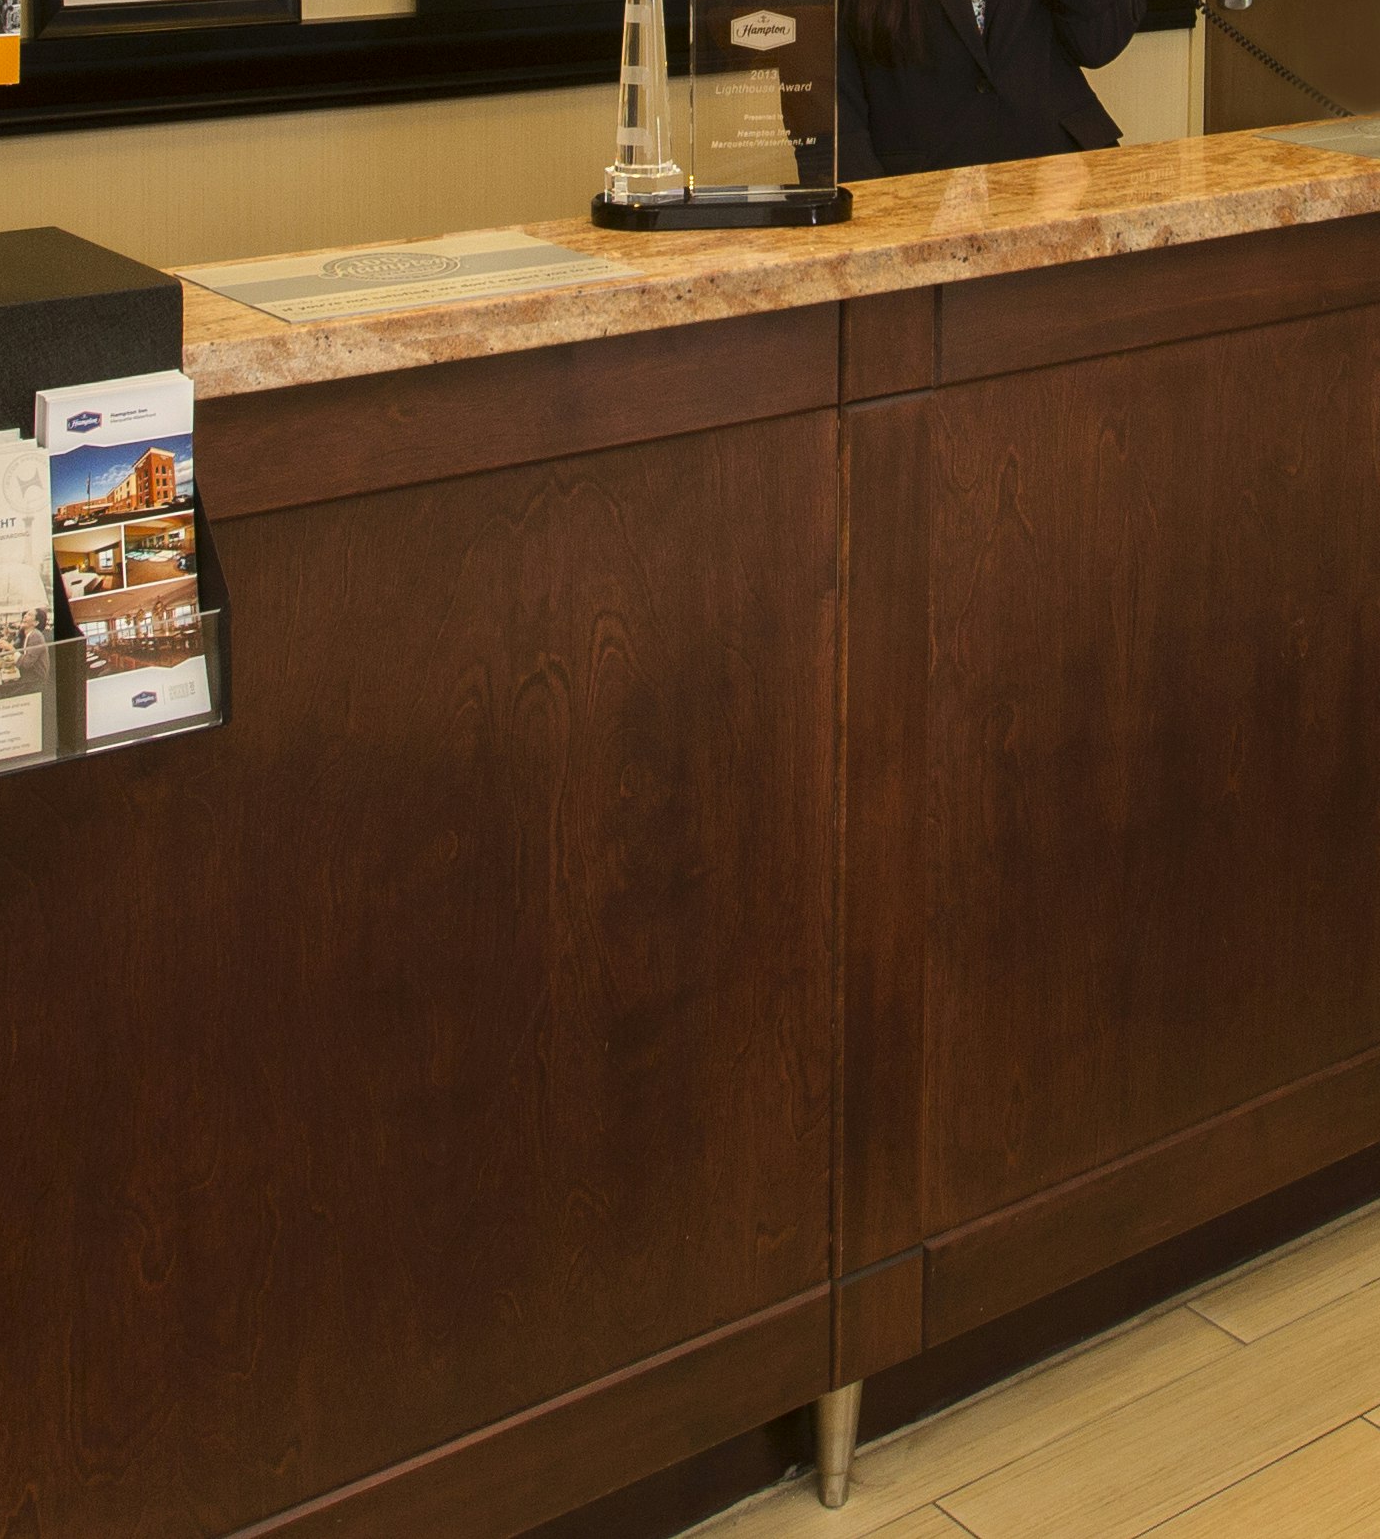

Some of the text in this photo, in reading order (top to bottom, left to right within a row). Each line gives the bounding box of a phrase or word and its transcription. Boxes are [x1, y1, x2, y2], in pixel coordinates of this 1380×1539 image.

[738, 24, 788, 37] Hampton
[750, 70, 778, 80] 2013
[715, 82, 812, 95] Lighthouse Award
[737, 130, 775, 139] Hampton
[806, 137, 817, 145] MI
[68, 417, 99, 429] Hampton
